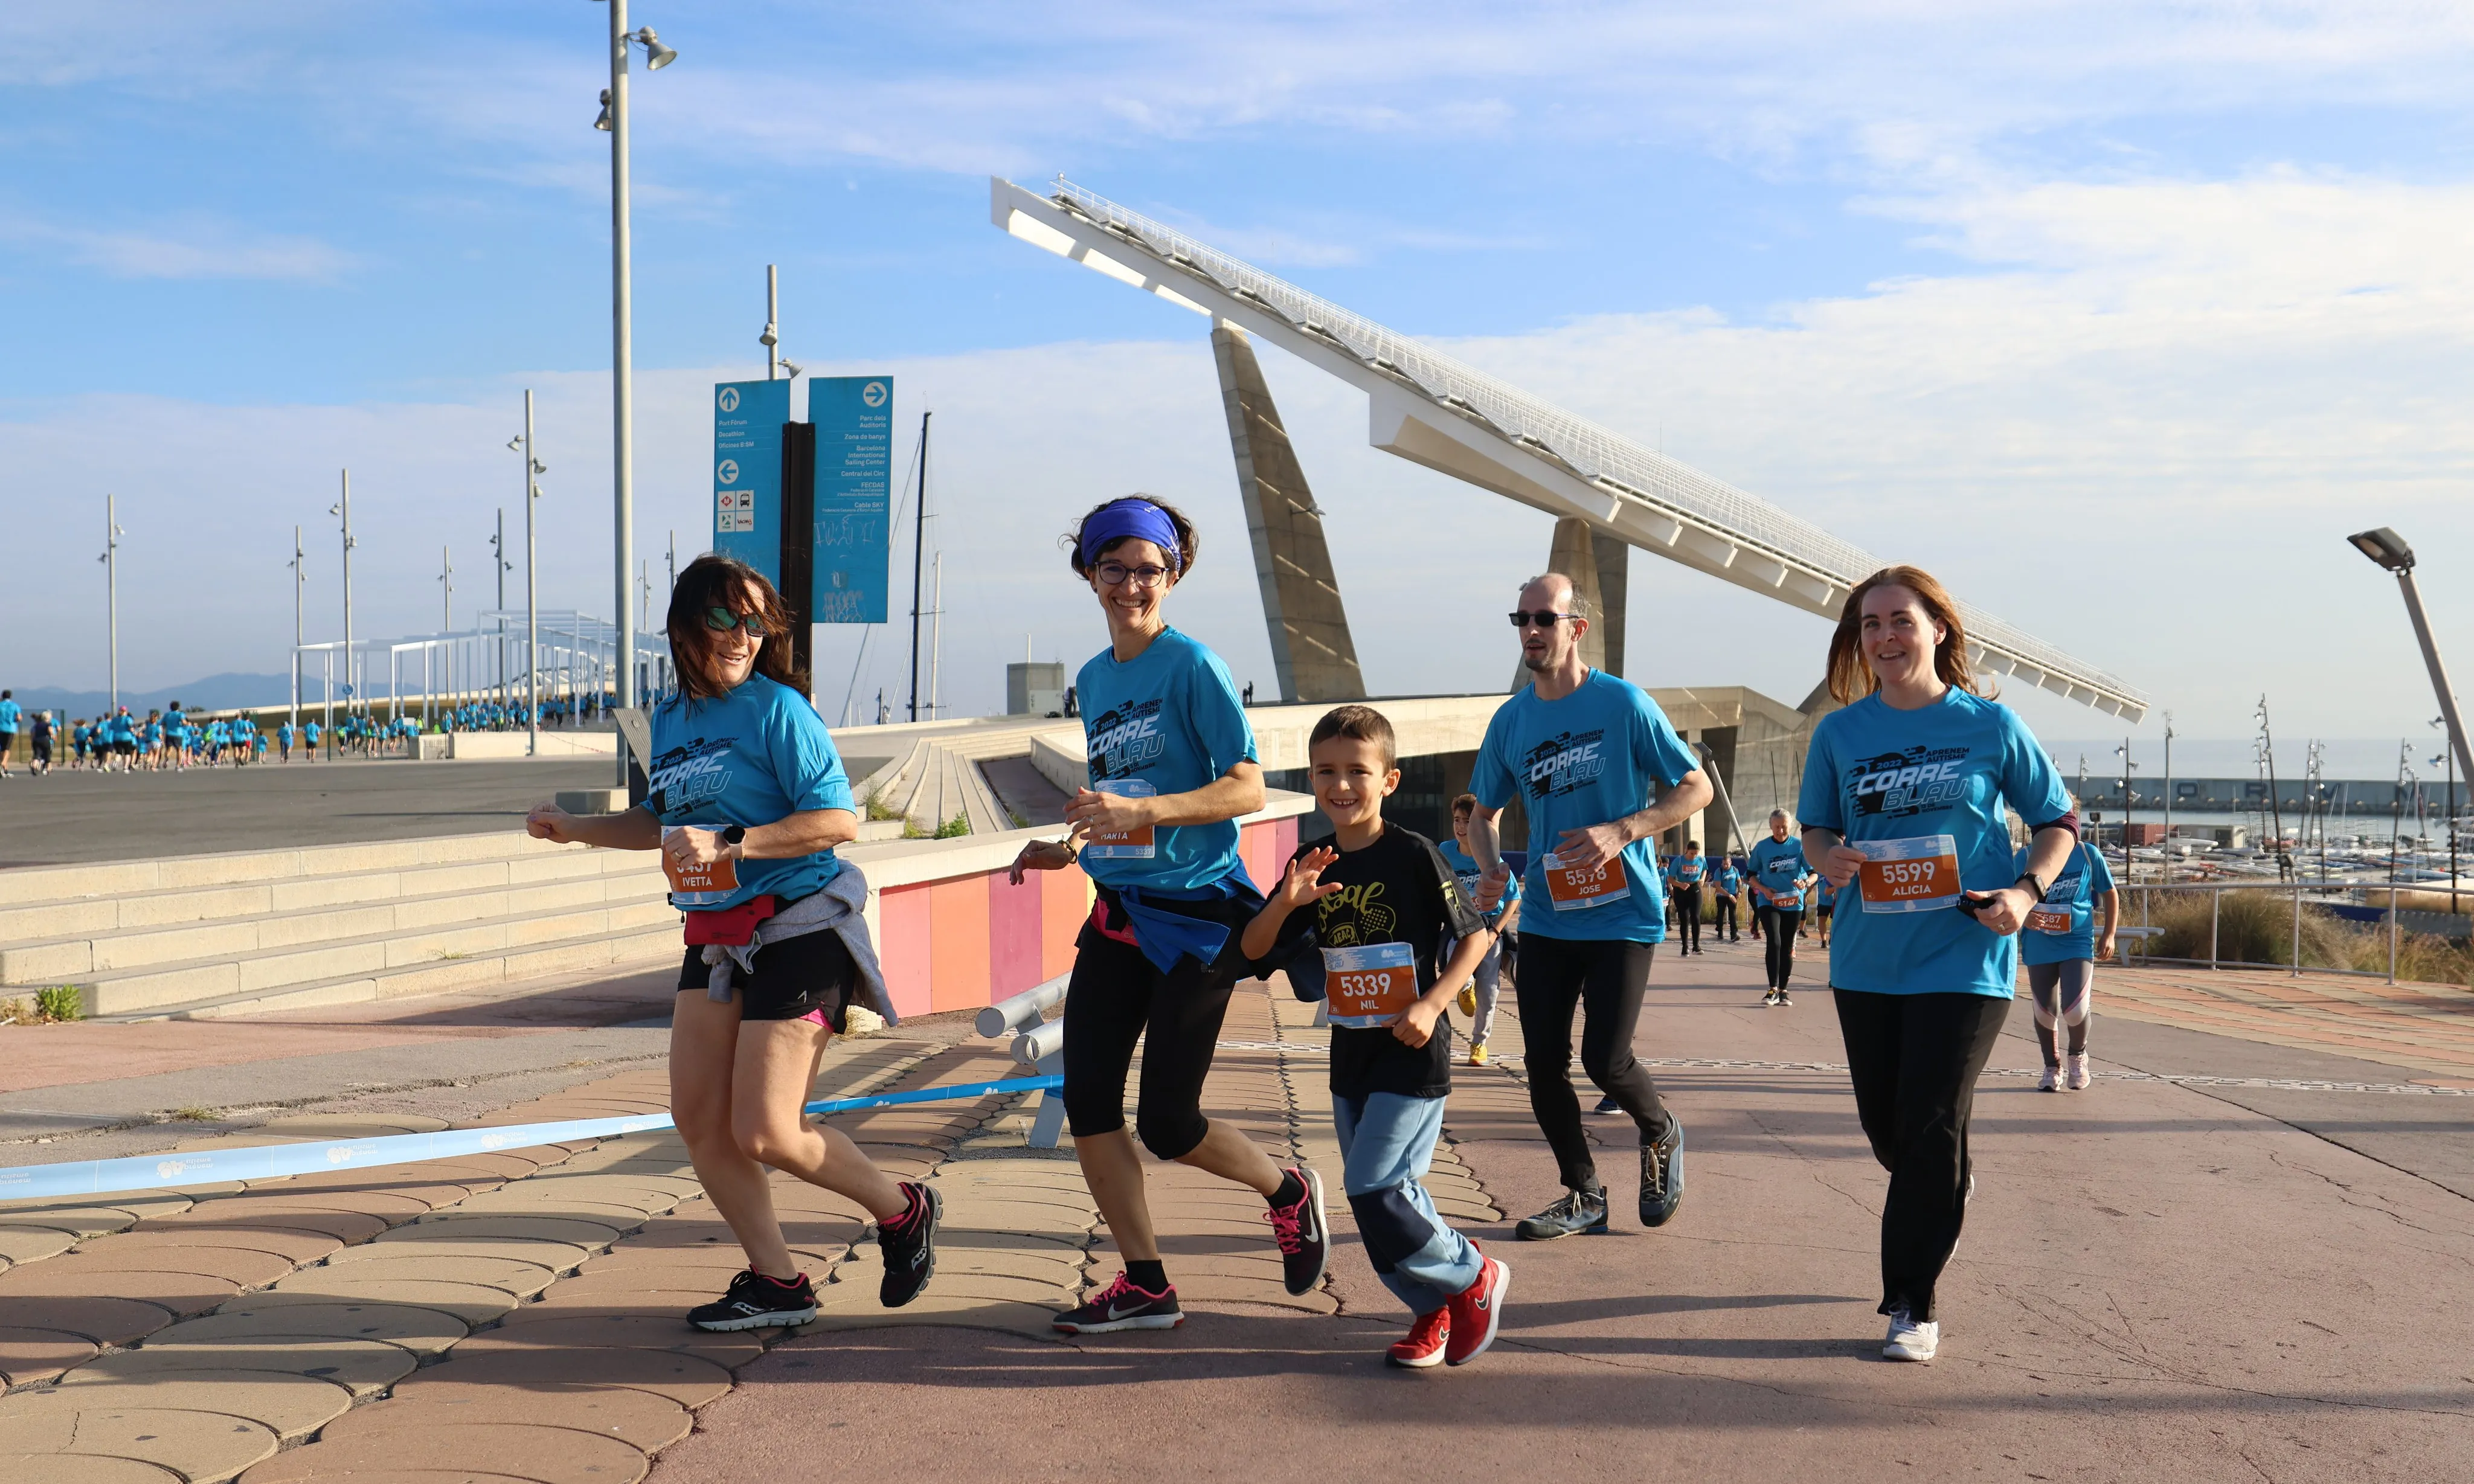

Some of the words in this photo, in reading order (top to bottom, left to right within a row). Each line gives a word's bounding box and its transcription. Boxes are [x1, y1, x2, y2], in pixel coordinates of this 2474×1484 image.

[1132, 697, 1163, 713] APRENEM
[1131, 705, 1160, 720] AUTISME
[1100, 718, 1116, 731] 2022
[1088, 714, 1160, 761] CORRE
[1570, 728, 1604, 742] APRENEM
[1572, 734, 1602, 748] AUTISME
[699, 741, 732, 756] AUTISME
[1105, 733, 1166, 774] BLAU
[1540, 747, 1557, 759] 2022
[1925, 747, 1970, 757] APRENEM
[663, 754, 684, 767] 2022
[1531, 742, 1602, 782] CORRE
[1877, 759, 1903, 769] 2022
[1926, 754, 1966, 763] AUTISME
[649, 750, 731, 795] CORRE
[1549, 757, 1607, 791] BLAU
[1857, 760, 1965, 796] CORRE
[665, 771, 733, 812] BLAU
[1881, 778, 1969, 812] BLAU
[1770, 858, 1797, 869] CORRE
[1882, 861, 1935, 884] 5599
[683, 876, 713, 887] IVETTA
[1579, 884, 1601, 895] JOSE
[1892, 884, 1932, 896] ALICIA
[1340, 973, 1390, 997] 5339
[1360, 1000, 1379, 1010] NIL
